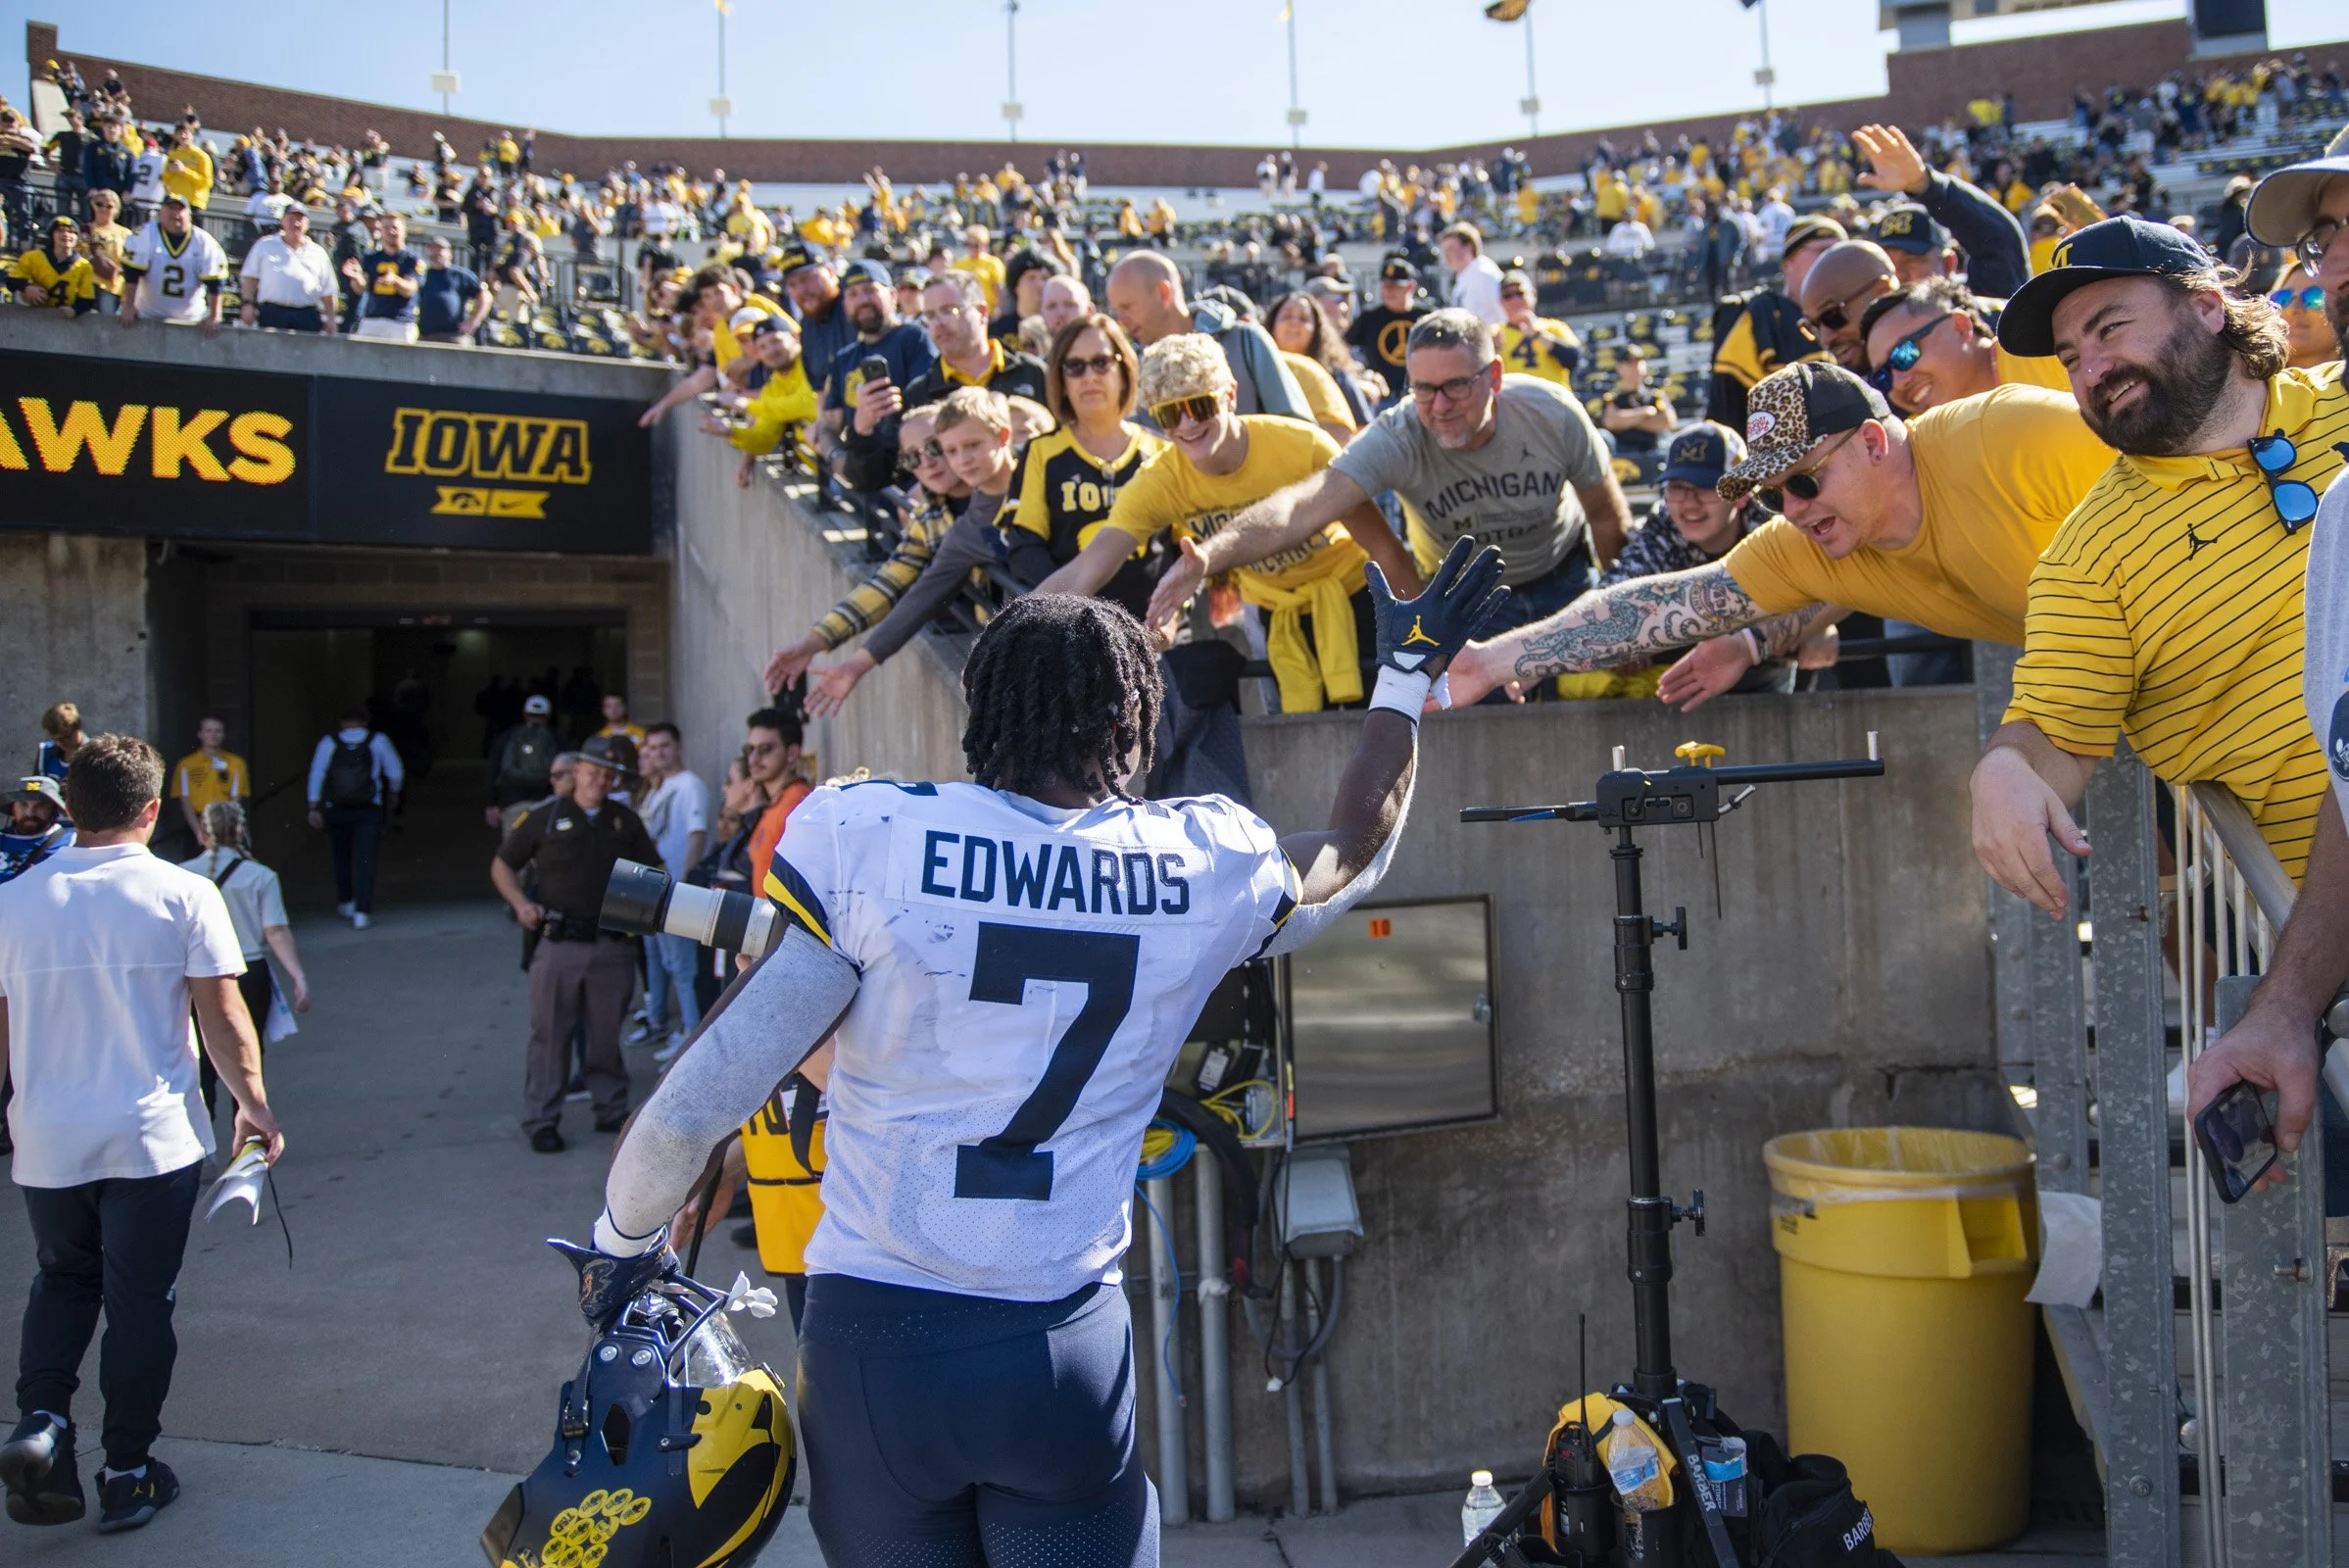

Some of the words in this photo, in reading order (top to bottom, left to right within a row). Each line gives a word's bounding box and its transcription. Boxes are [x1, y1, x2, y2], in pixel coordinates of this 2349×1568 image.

[163, 265, 185, 298] 2
[1511, 335, 1539, 368] 4
[384, 407, 592, 484] IOWA
[1425, 470, 1561, 520] MICHIGAN
[921, 829, 1191, 916] EDWARDS
[953, 920, 1141, 1201] 7
[1687, 1453, 1717, 1512] BARBER
